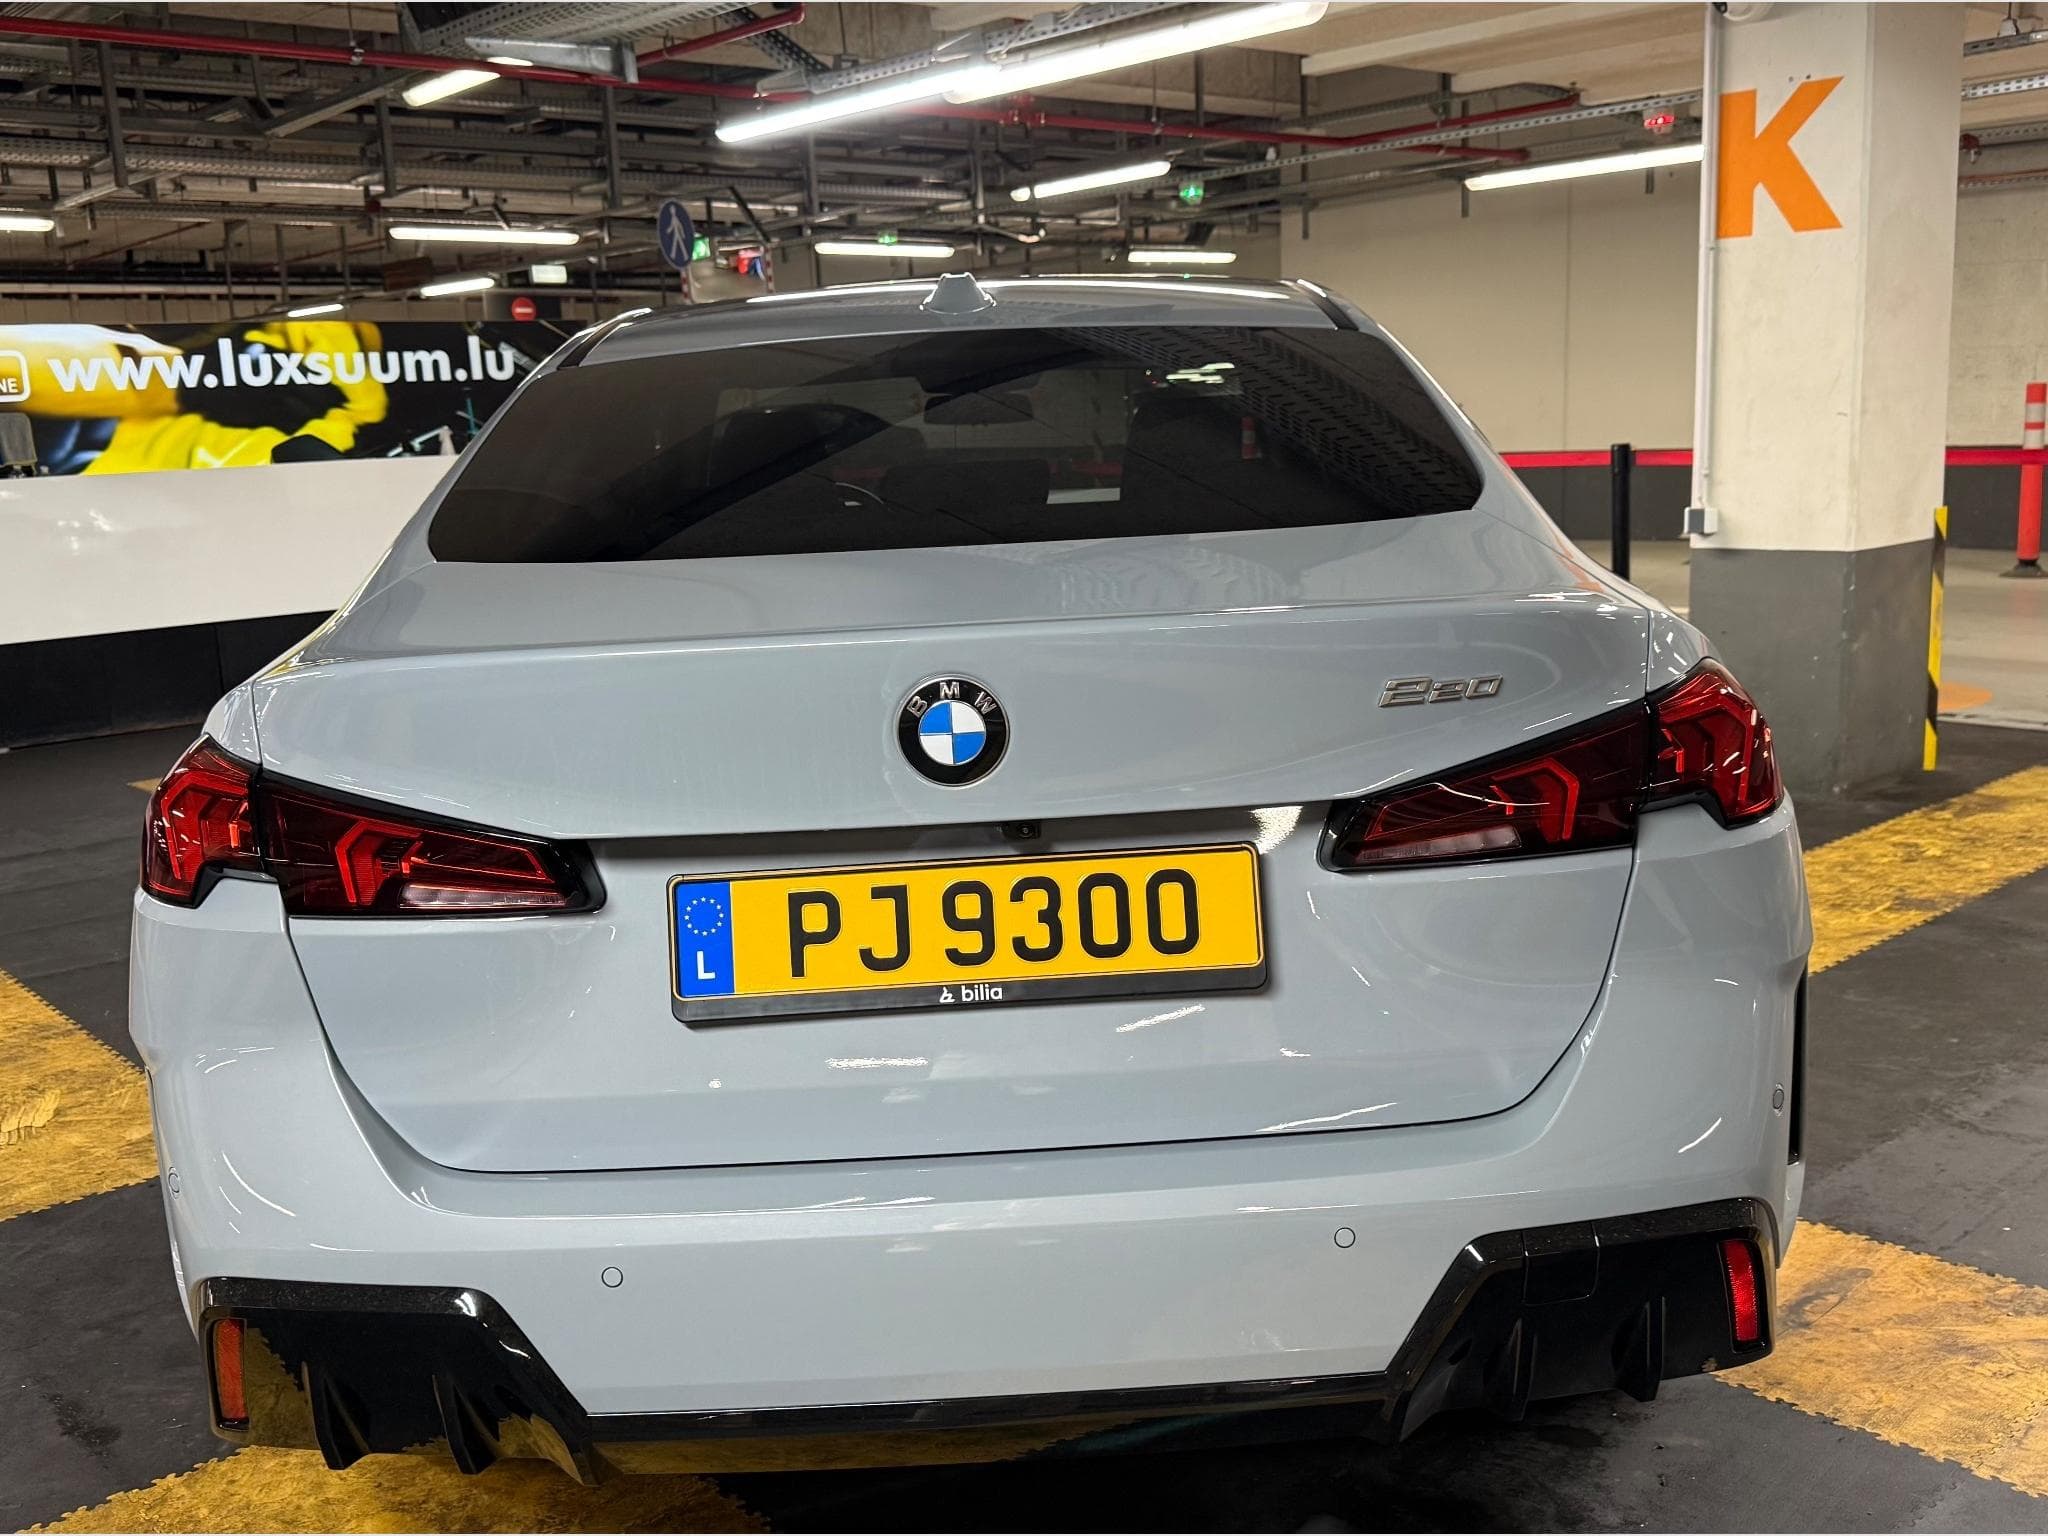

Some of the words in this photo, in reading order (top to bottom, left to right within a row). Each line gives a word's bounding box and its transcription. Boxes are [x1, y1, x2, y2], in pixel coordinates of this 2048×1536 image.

[1716, 76, 1844, 240] K
[48, 335, 515, 392] www.luxsuum.lu
[906, 682, 997, 718] BMW
[1379, 674, 1503, 707] 220
[788, 884, 911, 978] PJ
[942, 869, 1200, 967] 9300
[697, 951, 716, 979] L
[961, 984, 1002, 1001] bilia
